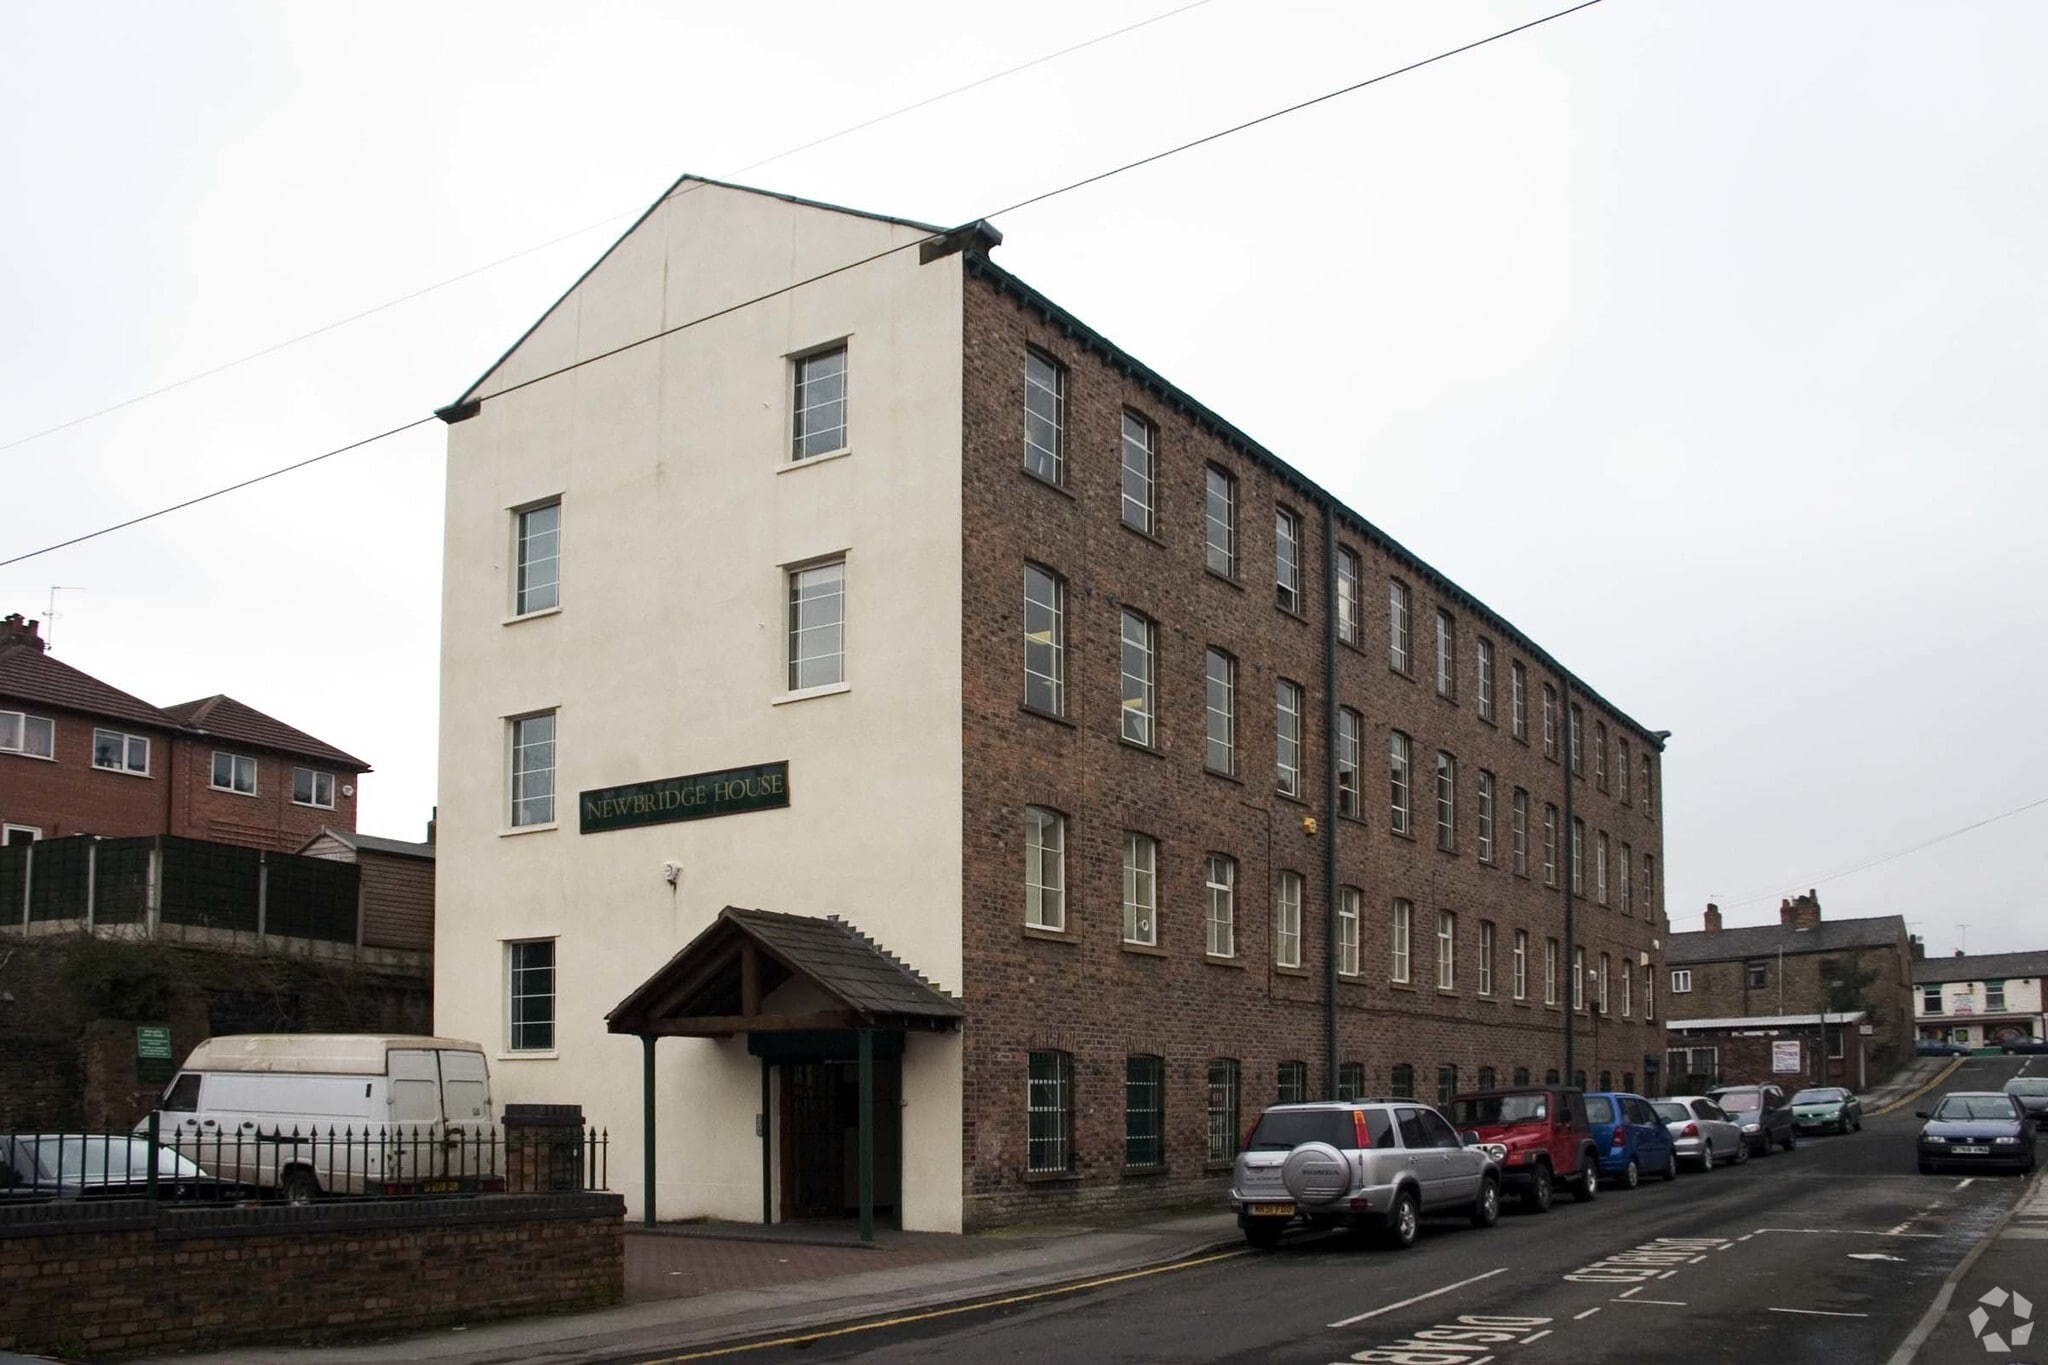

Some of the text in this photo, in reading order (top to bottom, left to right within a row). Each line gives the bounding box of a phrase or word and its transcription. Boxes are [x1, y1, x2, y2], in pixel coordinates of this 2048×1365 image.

[587, 774, 784, 820] NEWBRIDGE HOUSE
[1301, 1168, 1340, 1176] HONDA
[1563, 1238, 1728, 1282] DISABLED
[1328, 1315, 1554, 1365] DISAB
